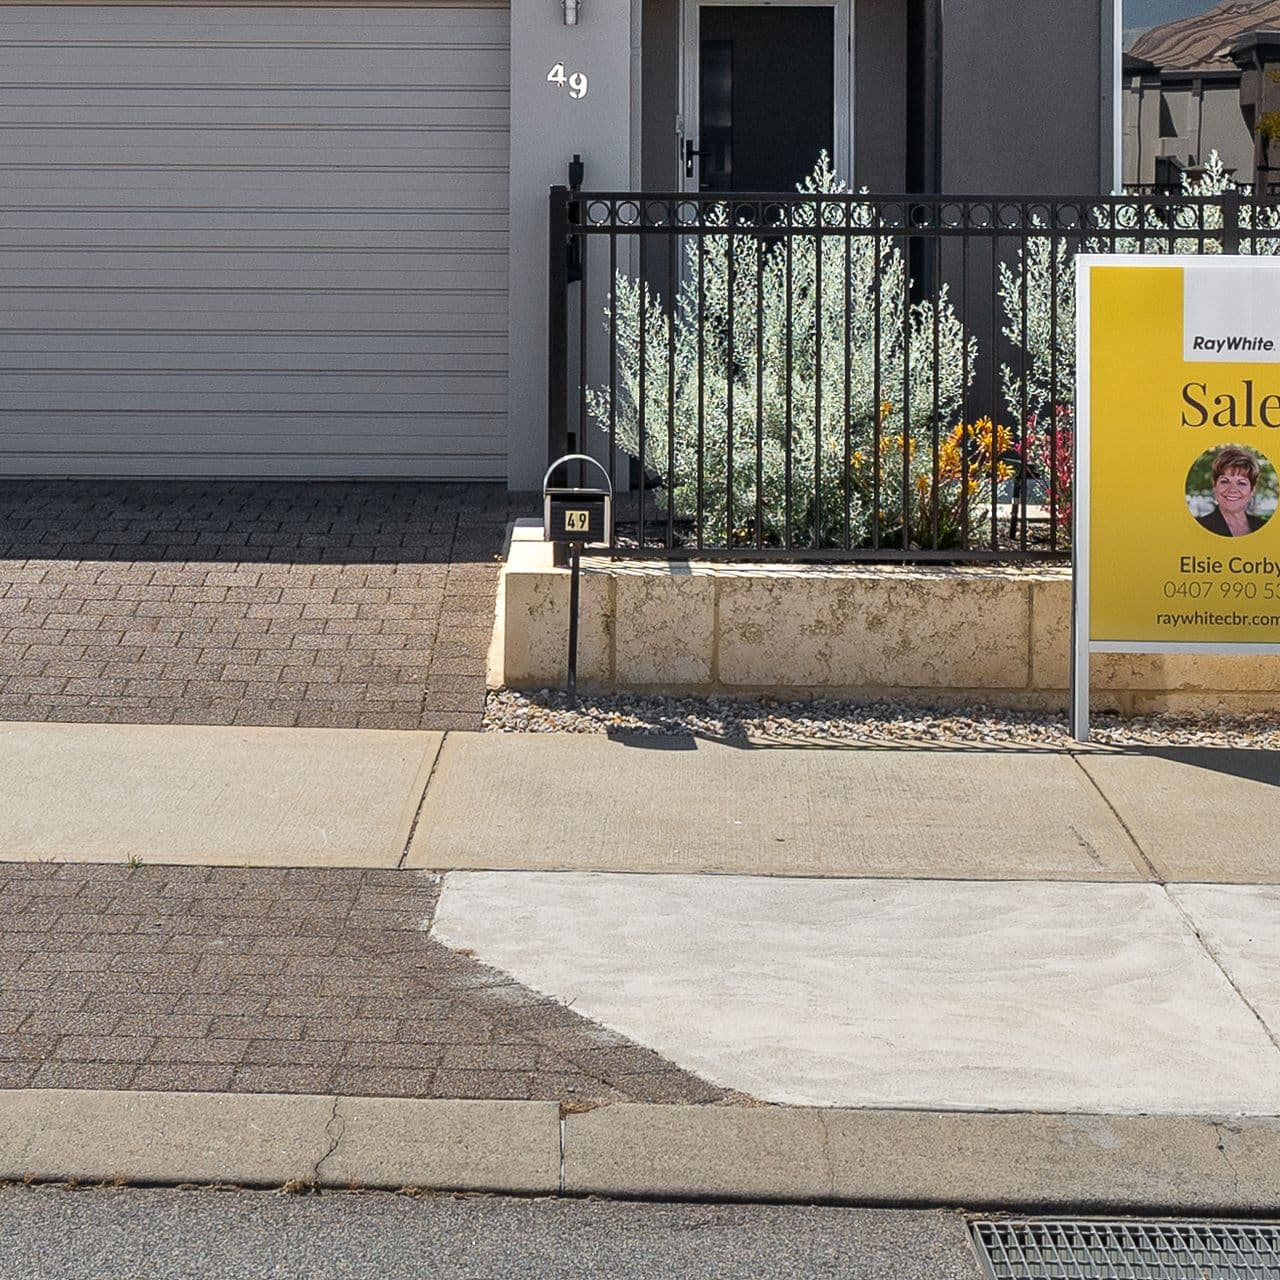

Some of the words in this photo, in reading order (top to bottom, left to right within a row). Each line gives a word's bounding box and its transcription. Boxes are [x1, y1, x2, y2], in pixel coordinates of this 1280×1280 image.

[546, 61, 588, 99] 49
[567, 513, 587, 529] 49
[1180, 556, 1223, 574] Elsie
[1163, 580, 1214, 599] 0407
[1219, 581, 1257, 599] 990
